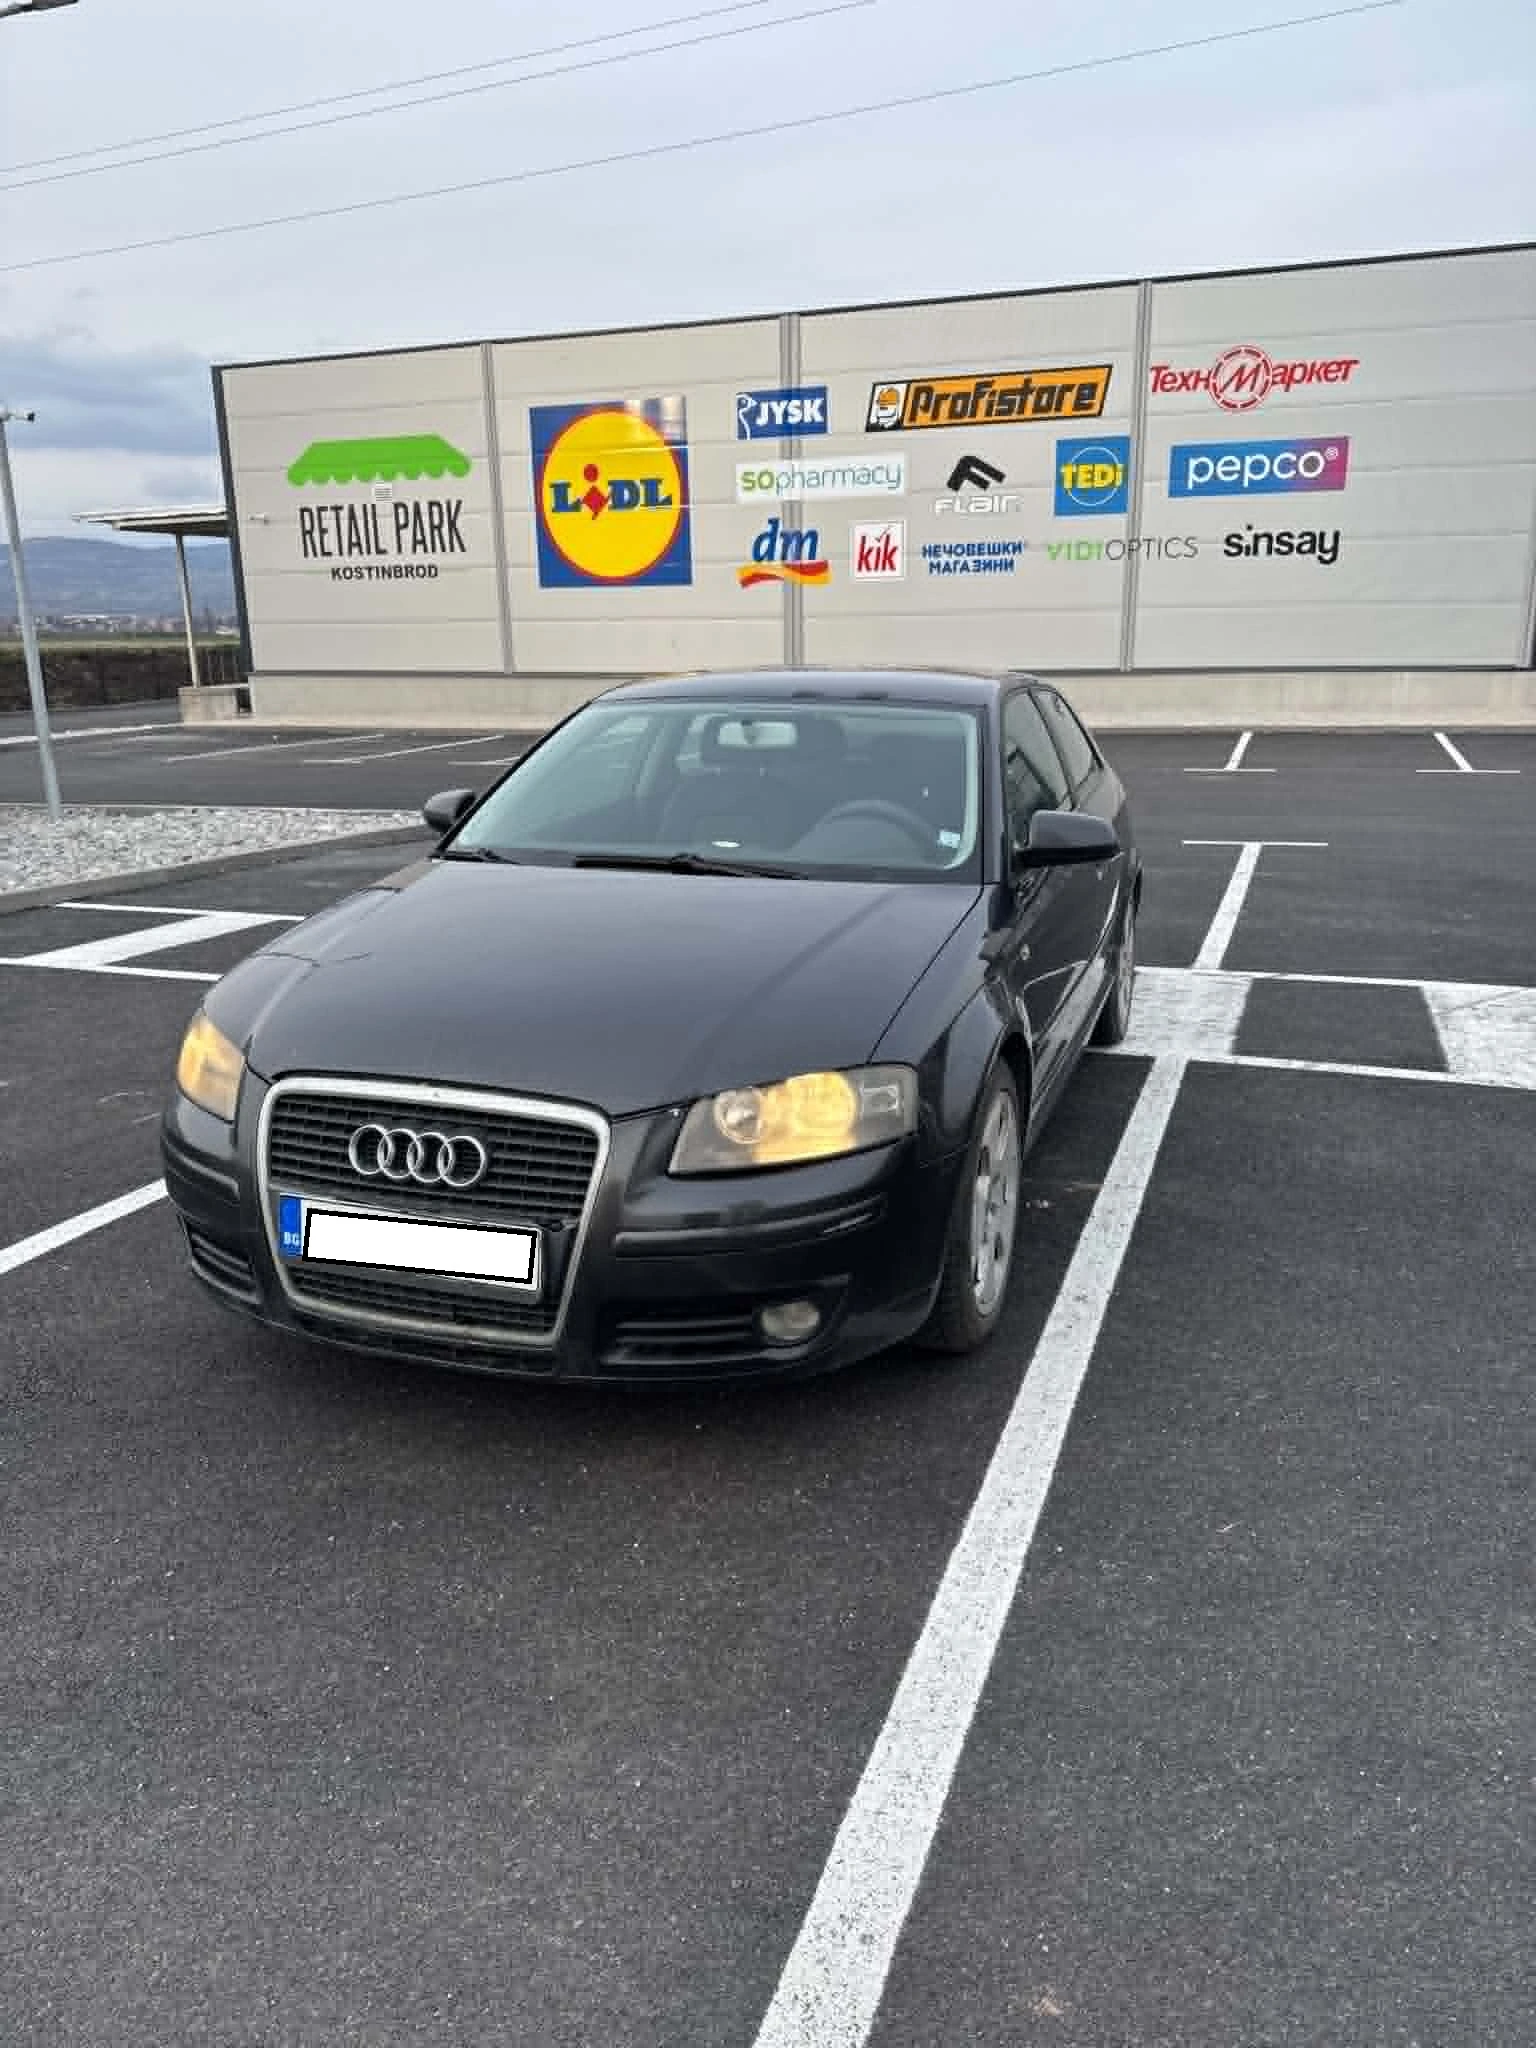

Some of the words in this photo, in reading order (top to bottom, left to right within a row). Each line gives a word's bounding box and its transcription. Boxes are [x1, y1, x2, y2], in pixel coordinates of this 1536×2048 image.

[756, 398, 824, 426] JYSK
[908, 380, 1097, 422] Profistore
[741, 463, 901, 496] sopharmacy
[301, 503, 387, 558] RETAIL
[394, 499, 467, 555] PARK
[752, 517, 818, 562] dm
[1223, 525, 1342, 564] sinsay
[921, 541, 1024, 559] НЕЧОВЕШКИ
[928, 557, 1015, 575] МАГАЗИНИ
[331, 564, 439, 582] KOSTINBROD
